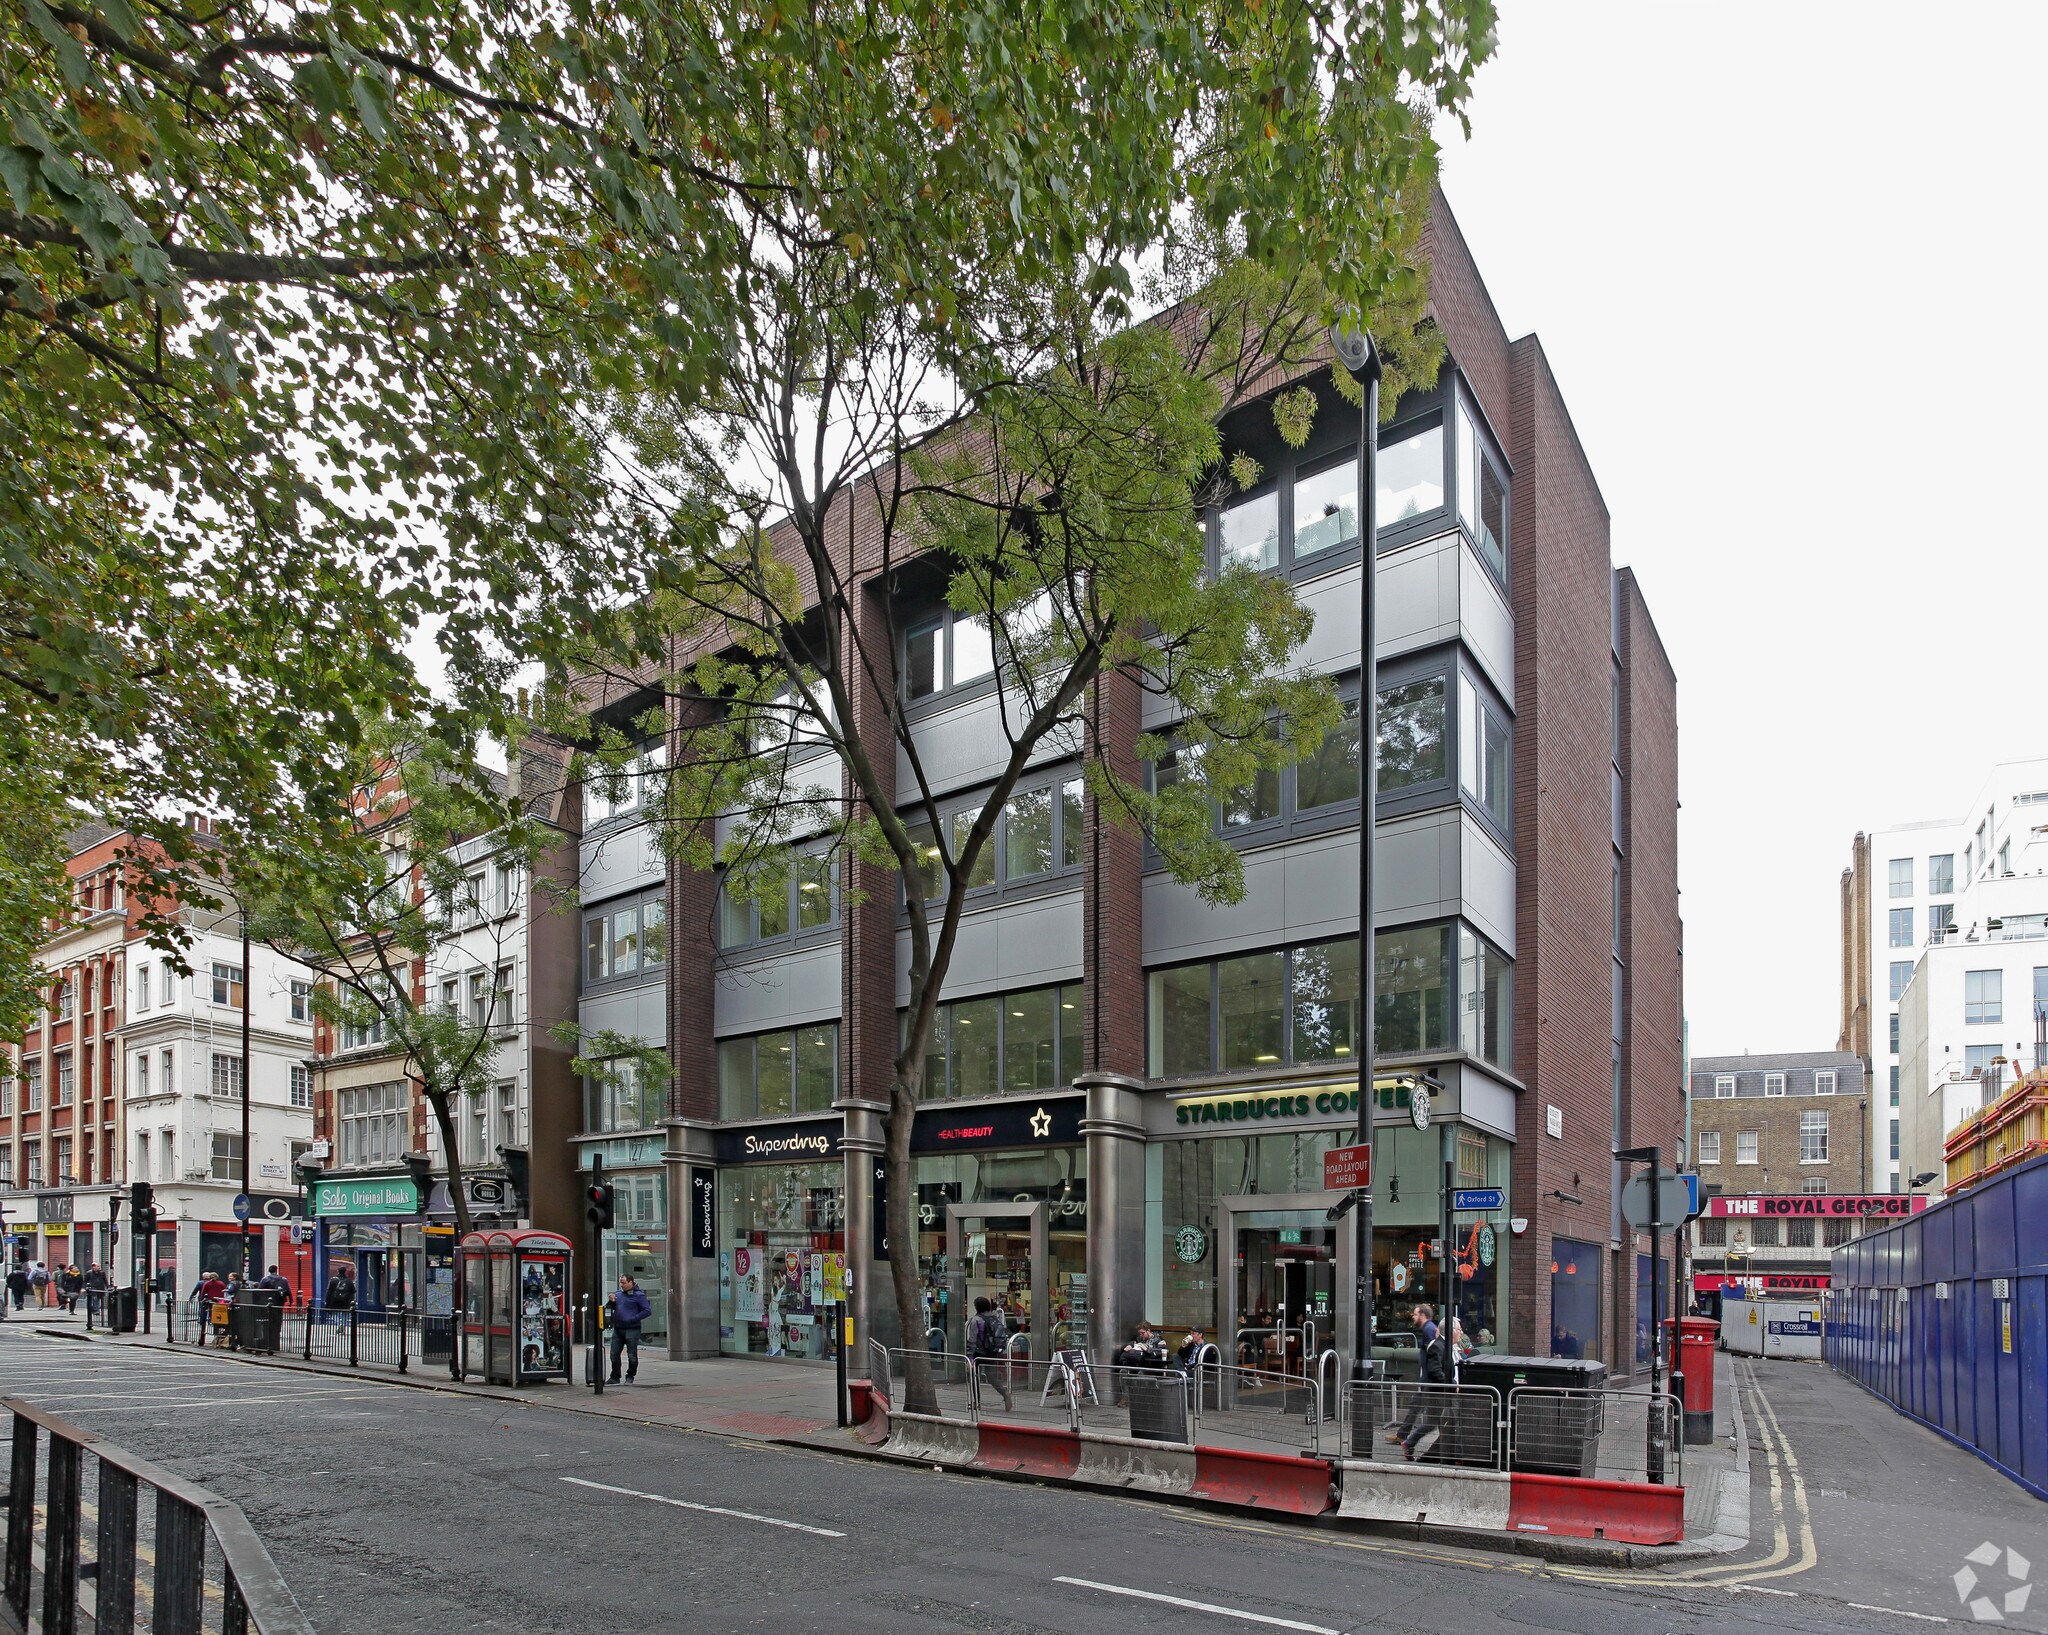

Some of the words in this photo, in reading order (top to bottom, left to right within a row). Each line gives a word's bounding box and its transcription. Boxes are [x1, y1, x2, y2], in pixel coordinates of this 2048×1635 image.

[1176, 1094, 1309, 1124] STARBUCKS
[938, 1126, 994, 1140] HEALTHBEAUTY
[745, 1133, 830, 1155] Superdrug
[631, 1143, 644, 1161] 27
[1339, 1151, 1354, 1162] NEW
[1326, 1164, 1343, 1175] ROAD
[1344, 1160, 1368, 1173] LAYOUT
[1335, 1172, 1357, 1184] AHEAD
[322, 1186, 347, 1206] Soho
[352, 1189, 383, 1208] Original
[385, 1188, 409, 1204] Books
[481, 1190, 496, 1198] HILL
[1466, 1195, 1487, 1203] Oxford
[1488, 1195, 1496, 1203] St
[55, 1197, 73, 1219] YES
[1725, 1200, 1758, 1214] THE
[1765, 1200, 1826, 1214] ROYAL
[1832, 1199, 1911, 1214] GEORGE
[702, 1181, 712, 1248] Superdrug
[1176, 1226, 1203, 1243] STARBUCKS
[1179, 1251, 1200, 1262] COFFEE
[1735, 1276, 1763, 1290] THE
[1768, 1277, 1826, 1289] ROYAL
[1783, 1322, 1808, 1331] Crossrail
